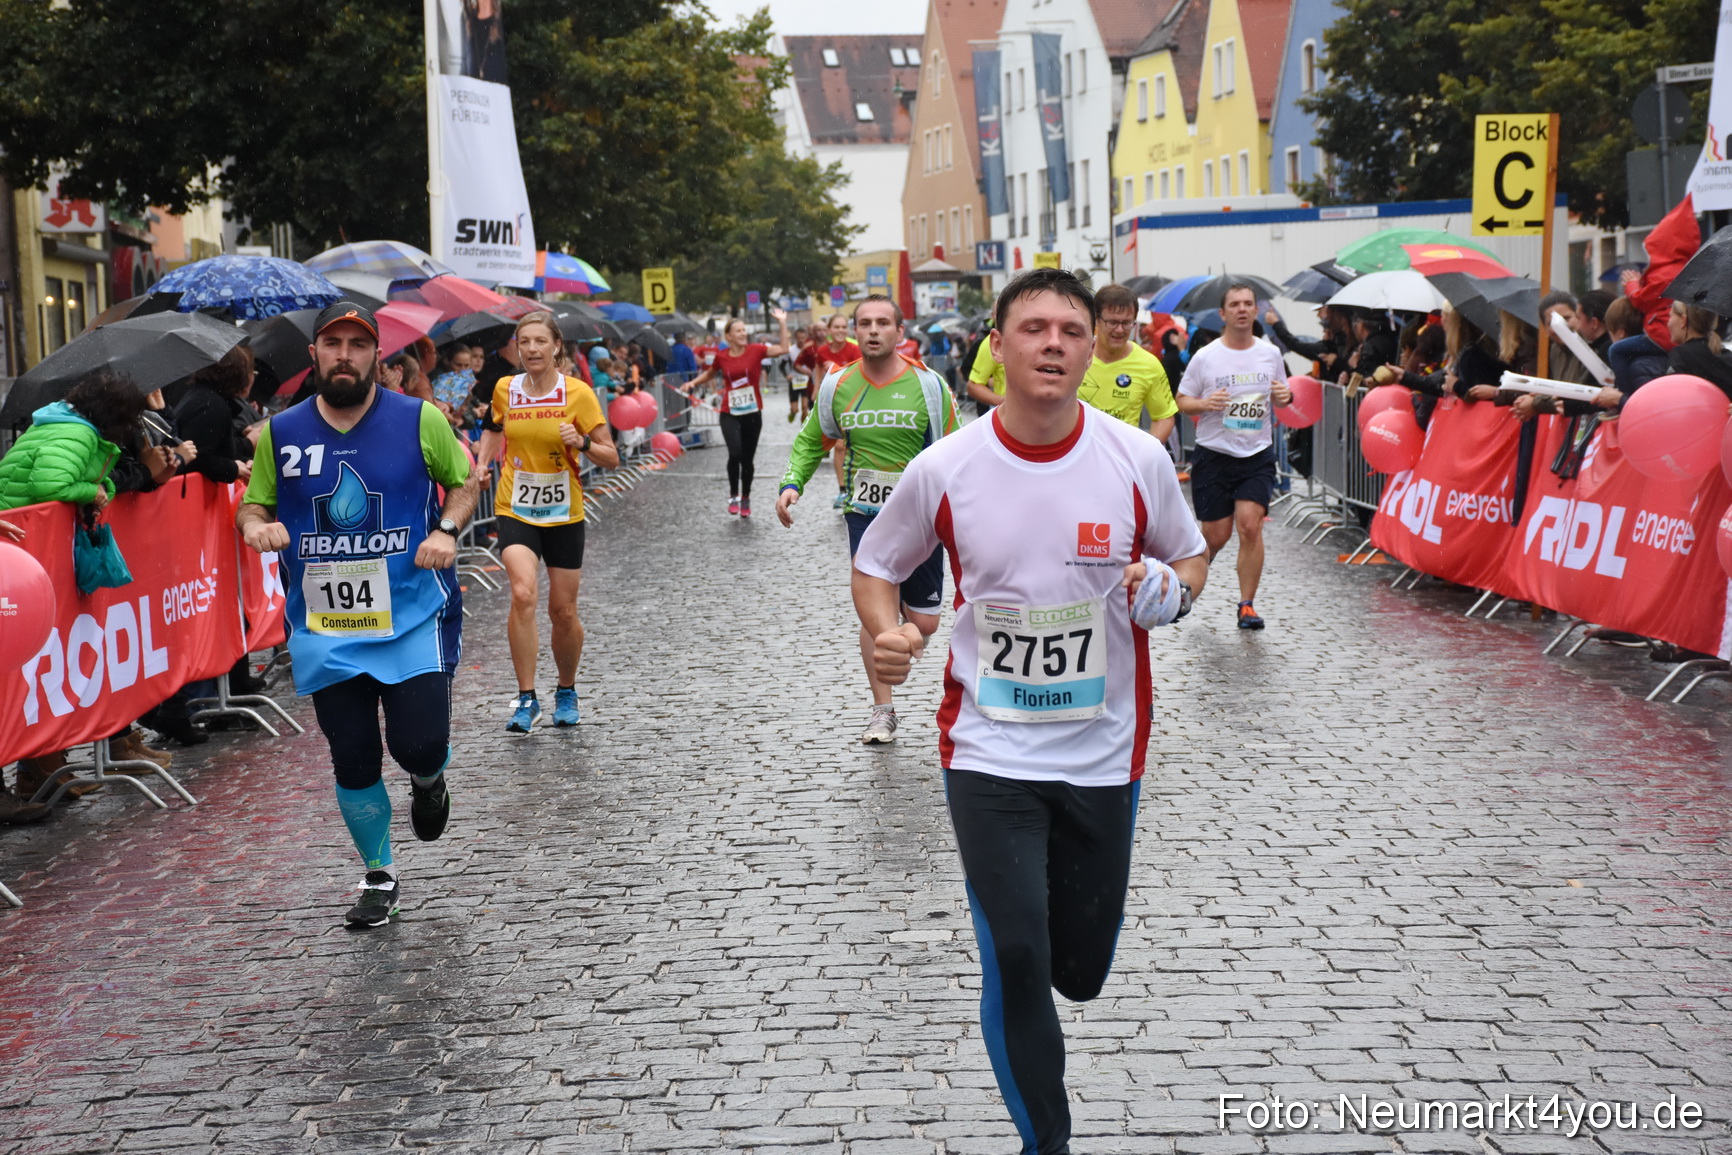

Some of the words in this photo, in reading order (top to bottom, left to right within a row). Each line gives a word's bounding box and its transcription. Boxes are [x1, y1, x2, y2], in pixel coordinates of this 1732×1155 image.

[1693, 65, 1713, 77] Gass
[1485, 120, 1549, 142] Block
[1493, 151, 1535, 210] C
[455, 218, 514, 245] swn
[651, 283, 666, 304] D
[731, 394, 754, 407] 2374
[1229, 403, 1264, 418] 2865
[508, 411, 532, 421] MAX
[536, 409, 567, 419] BÖGL
[841, 409, 918, 430] BOCK
[280, 444, 325, 478] 21
[518, 484, 565, 505] 2755
[857, 481, 894, 504] 286
[530, 509, 551, 517] Petra
[300, 531, 406, 555] FIBALON
[1080, 544, 1108, 555] DKMS
[336, 562, 380, 575] BOCK
[320, 580, 374, 610] 194
[321, 616, 378, 629] Constantin
[984, 614, 1023, 626] NeuerMarkt
[1029, 603, 1092, 625] BOCK
[991, 628, 1093, 677] 2757
[1013, 687, 1072, 706] Florian
